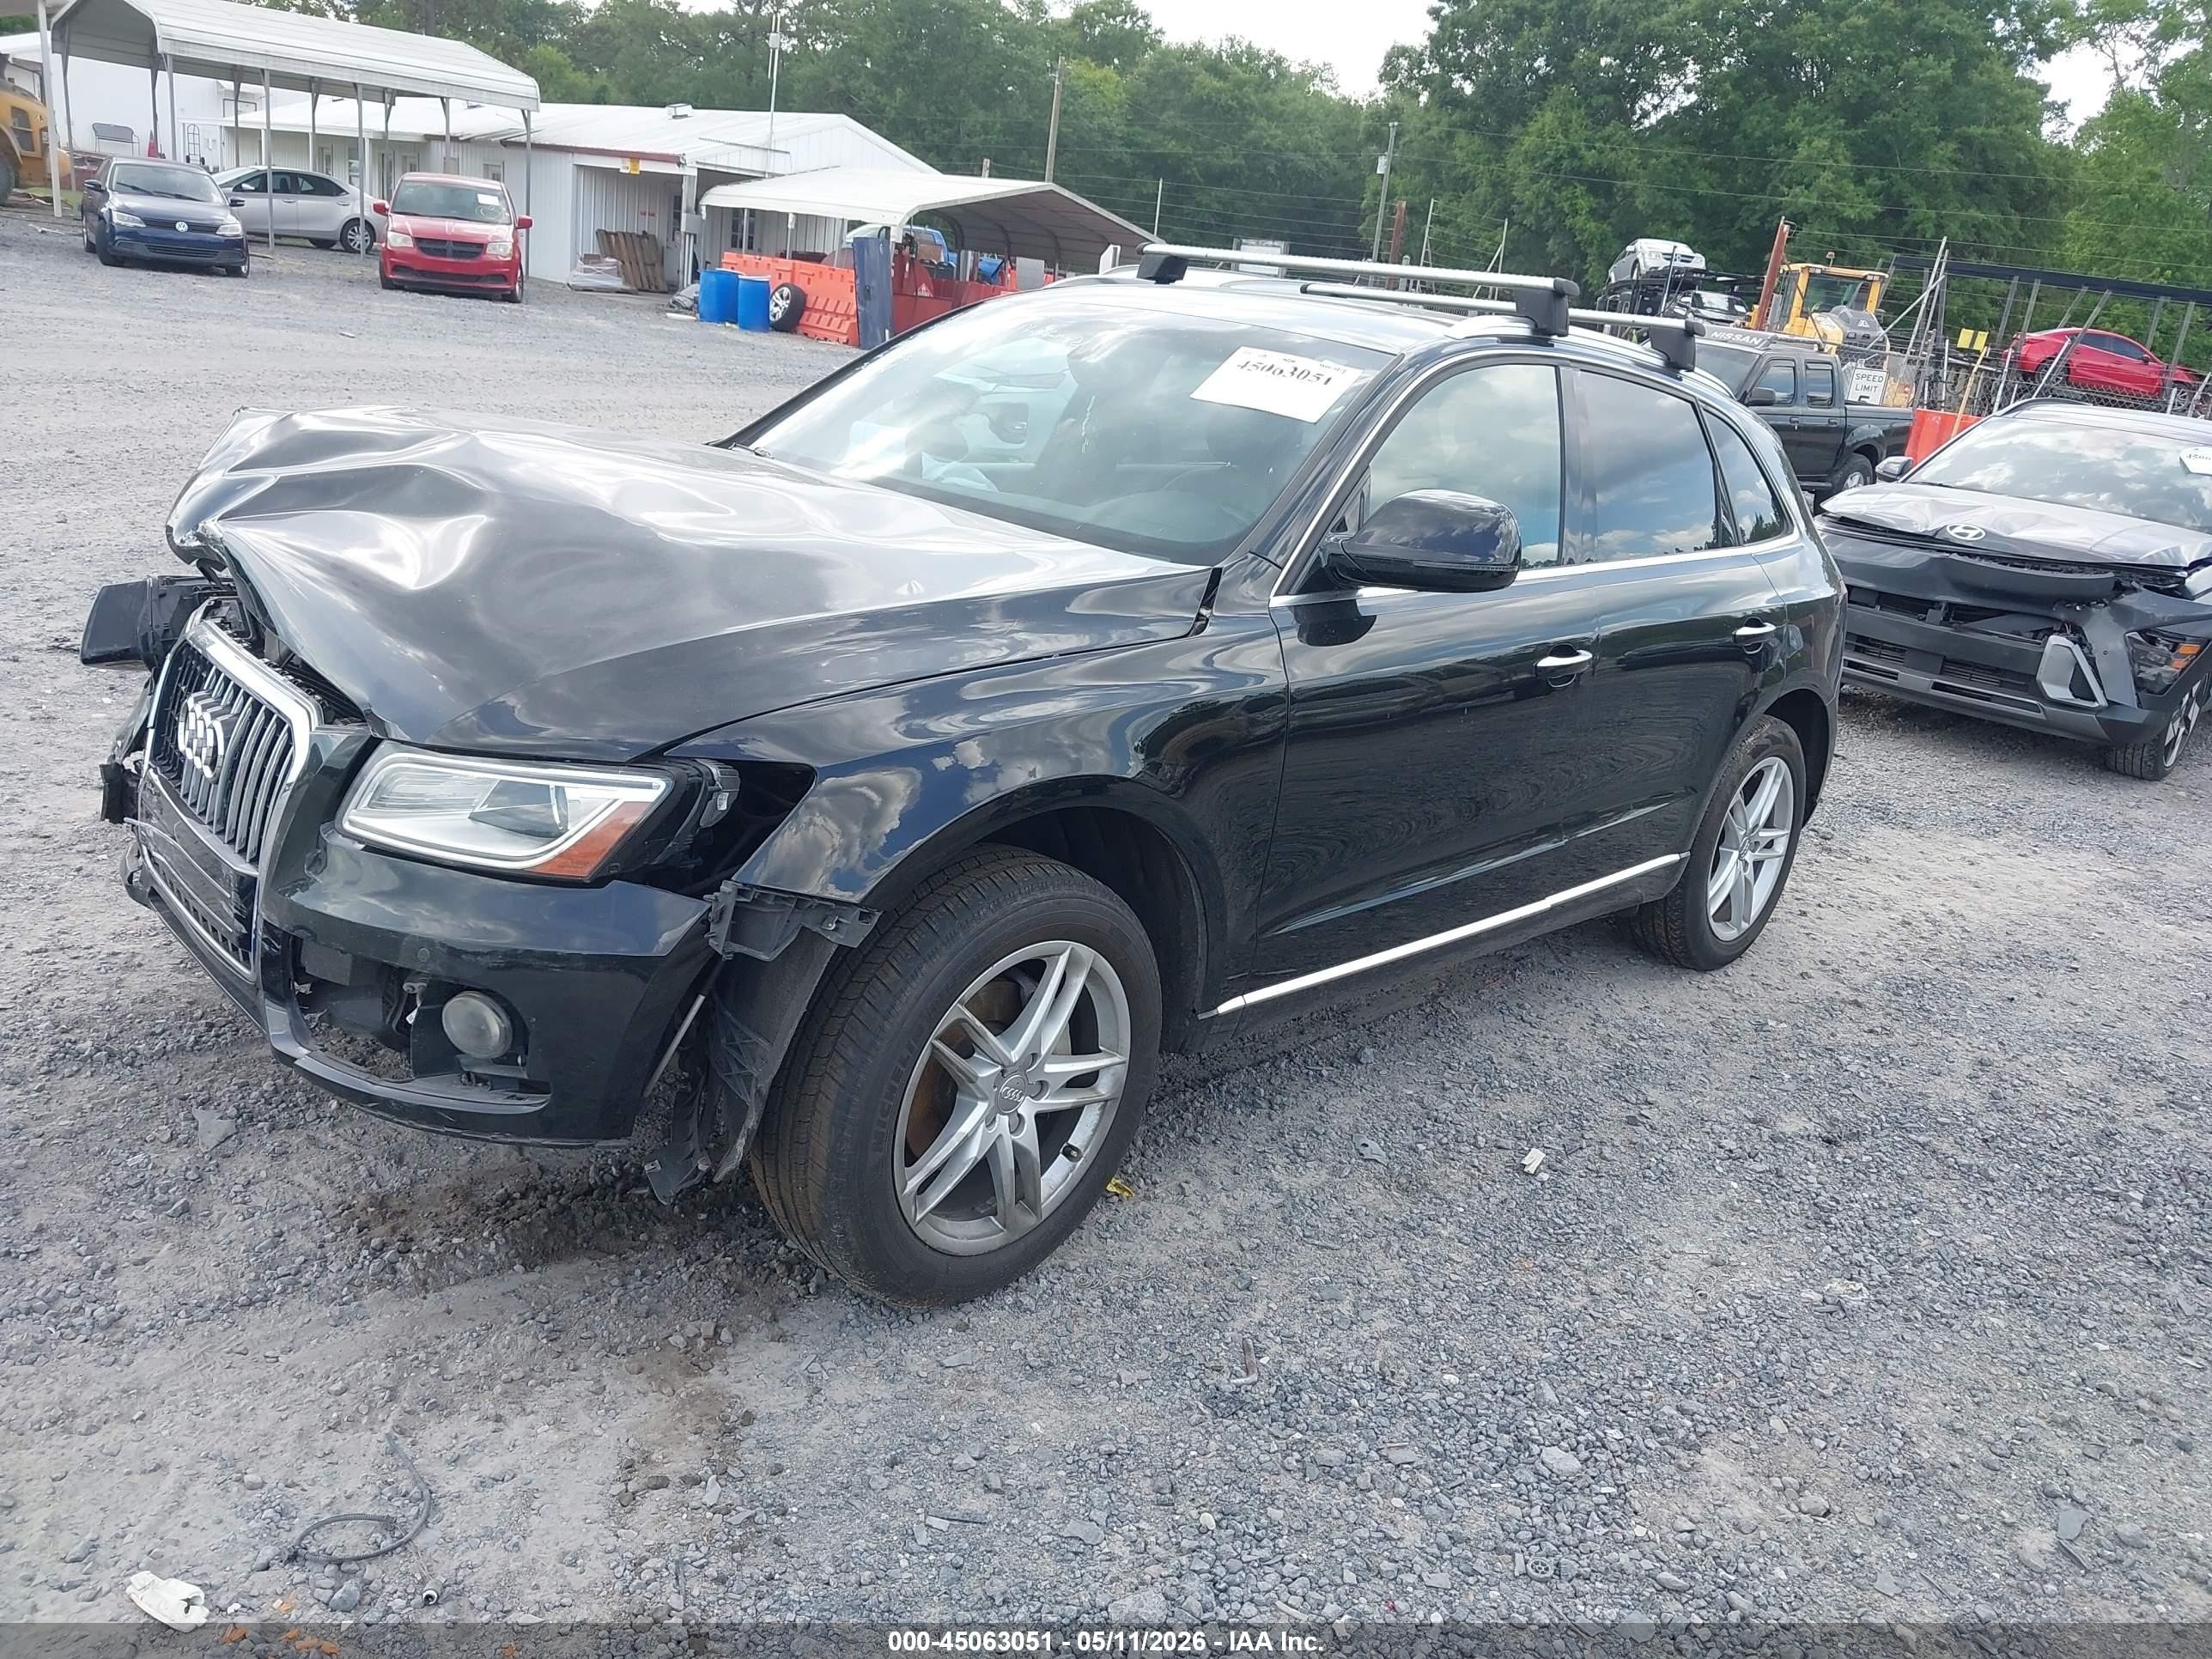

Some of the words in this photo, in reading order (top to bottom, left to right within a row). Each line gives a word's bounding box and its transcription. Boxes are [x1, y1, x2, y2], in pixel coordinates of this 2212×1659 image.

[1711, 331, 1763, 345] NISSAN
[1855, 373, 1884, 383] SPEED
[1855, 384, 1879, 393] LIMIT
